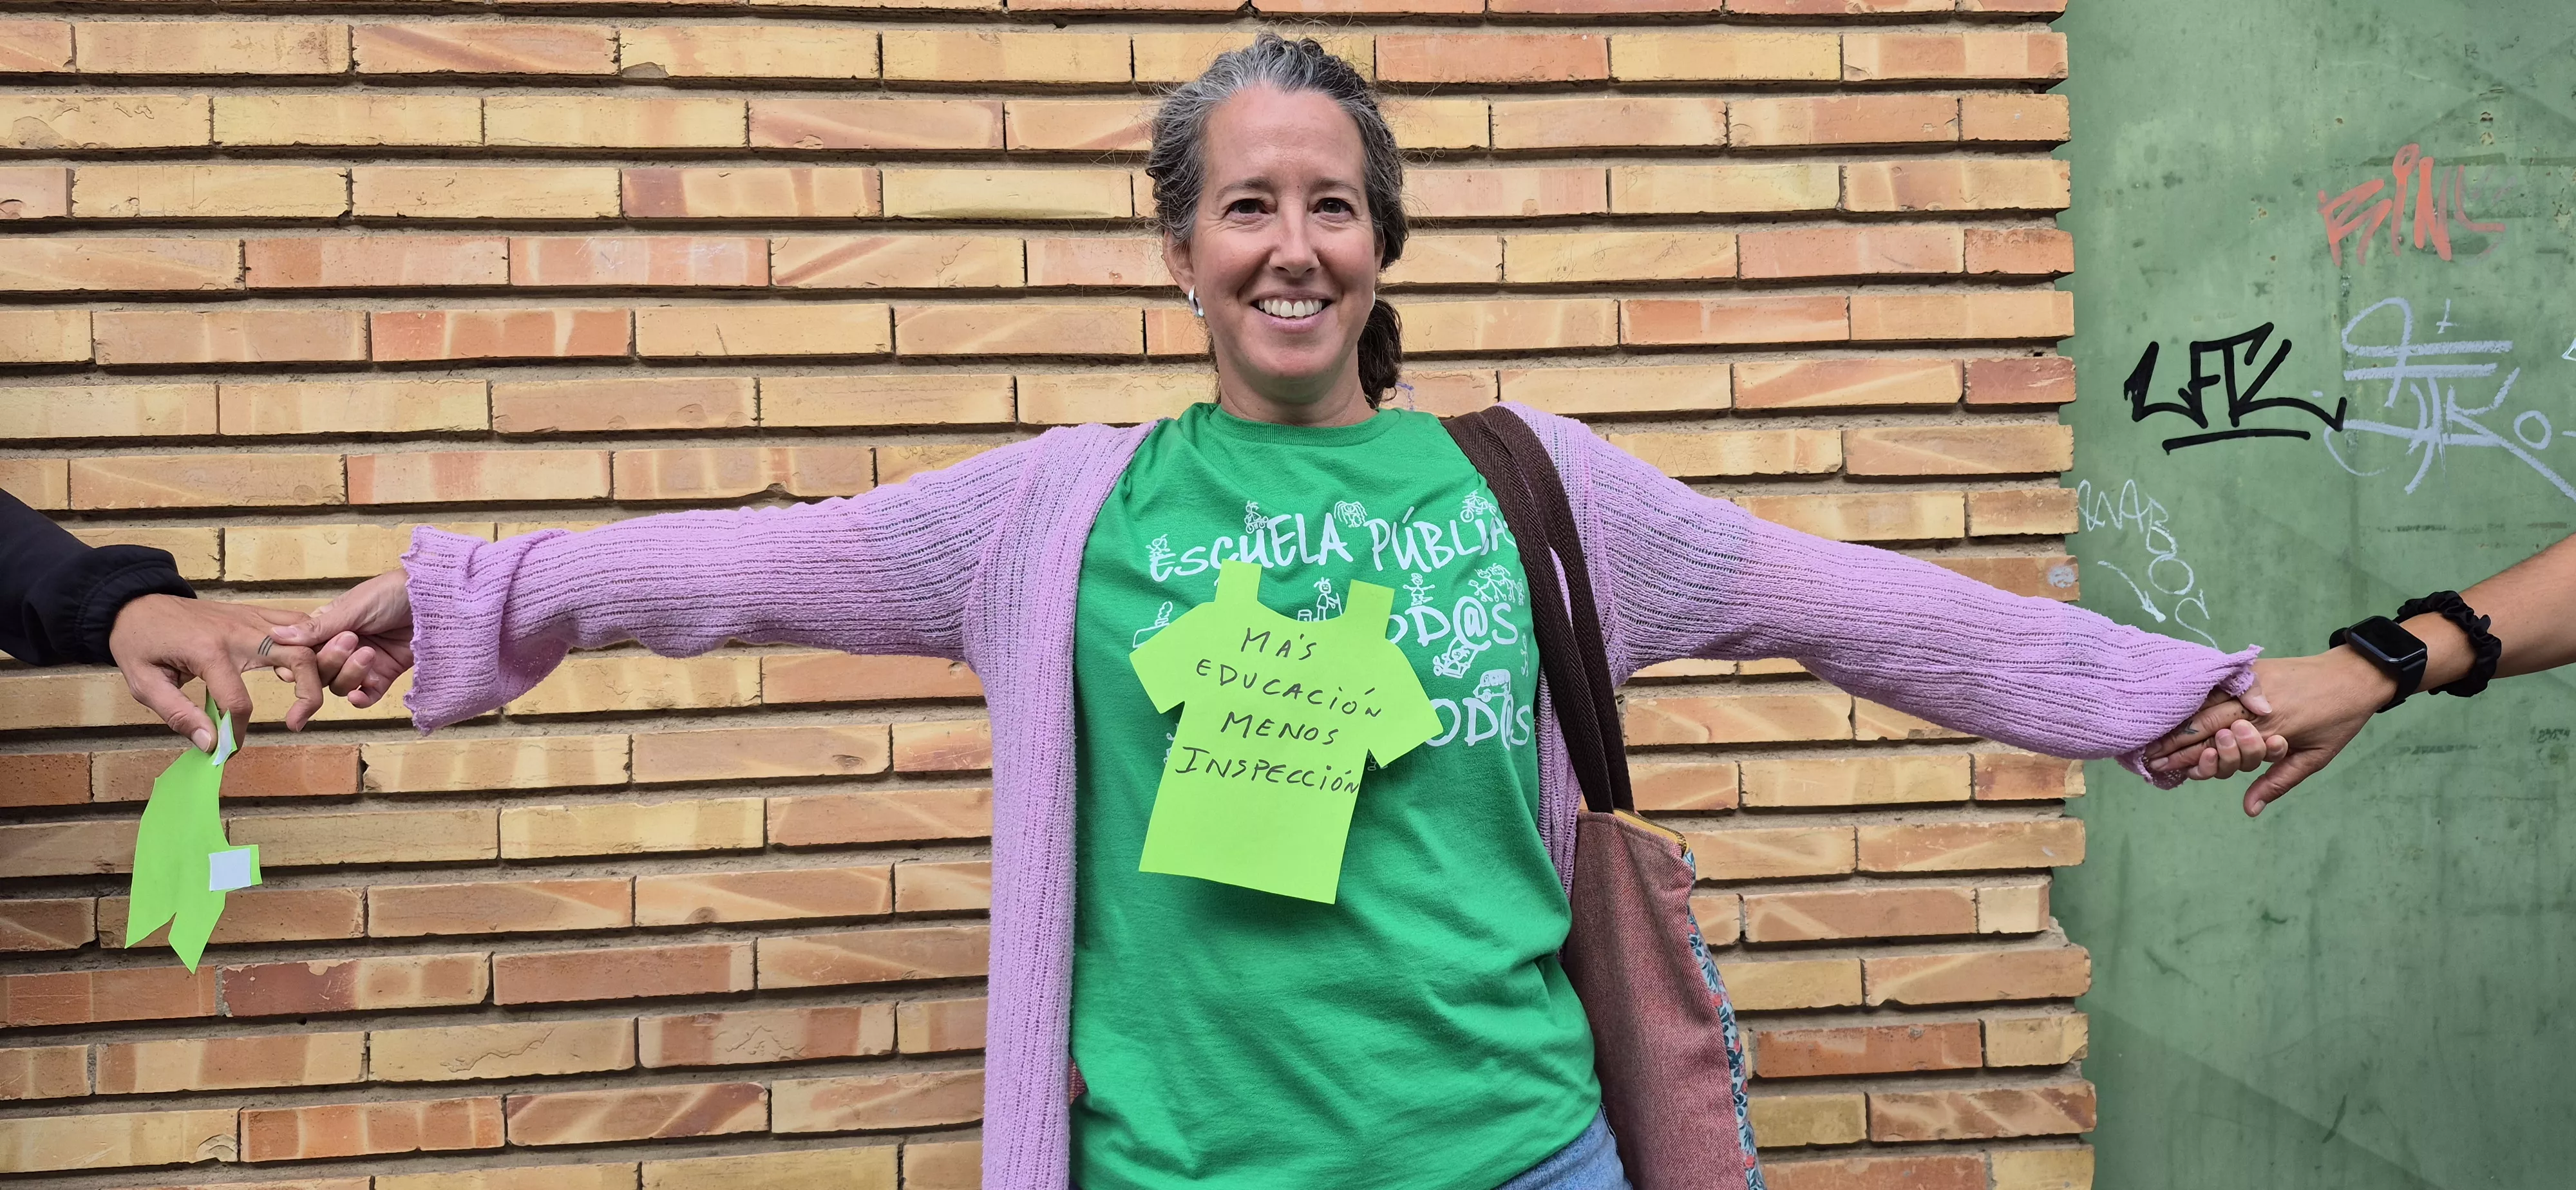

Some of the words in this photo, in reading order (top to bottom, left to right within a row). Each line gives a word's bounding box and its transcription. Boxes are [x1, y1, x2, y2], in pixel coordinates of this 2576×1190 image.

[1149, 513, 1354, 582] ESCUELA
[1240, 627, 1318, 660] MÁS
[1387, 596, 1519, 651] OD@S
[1196, 658, 1382, 717] EDUCACIÓN
[1220, 711, 1340, 746] MENOS
[1175, 746, 1360, 794] INSPECCIÓN
